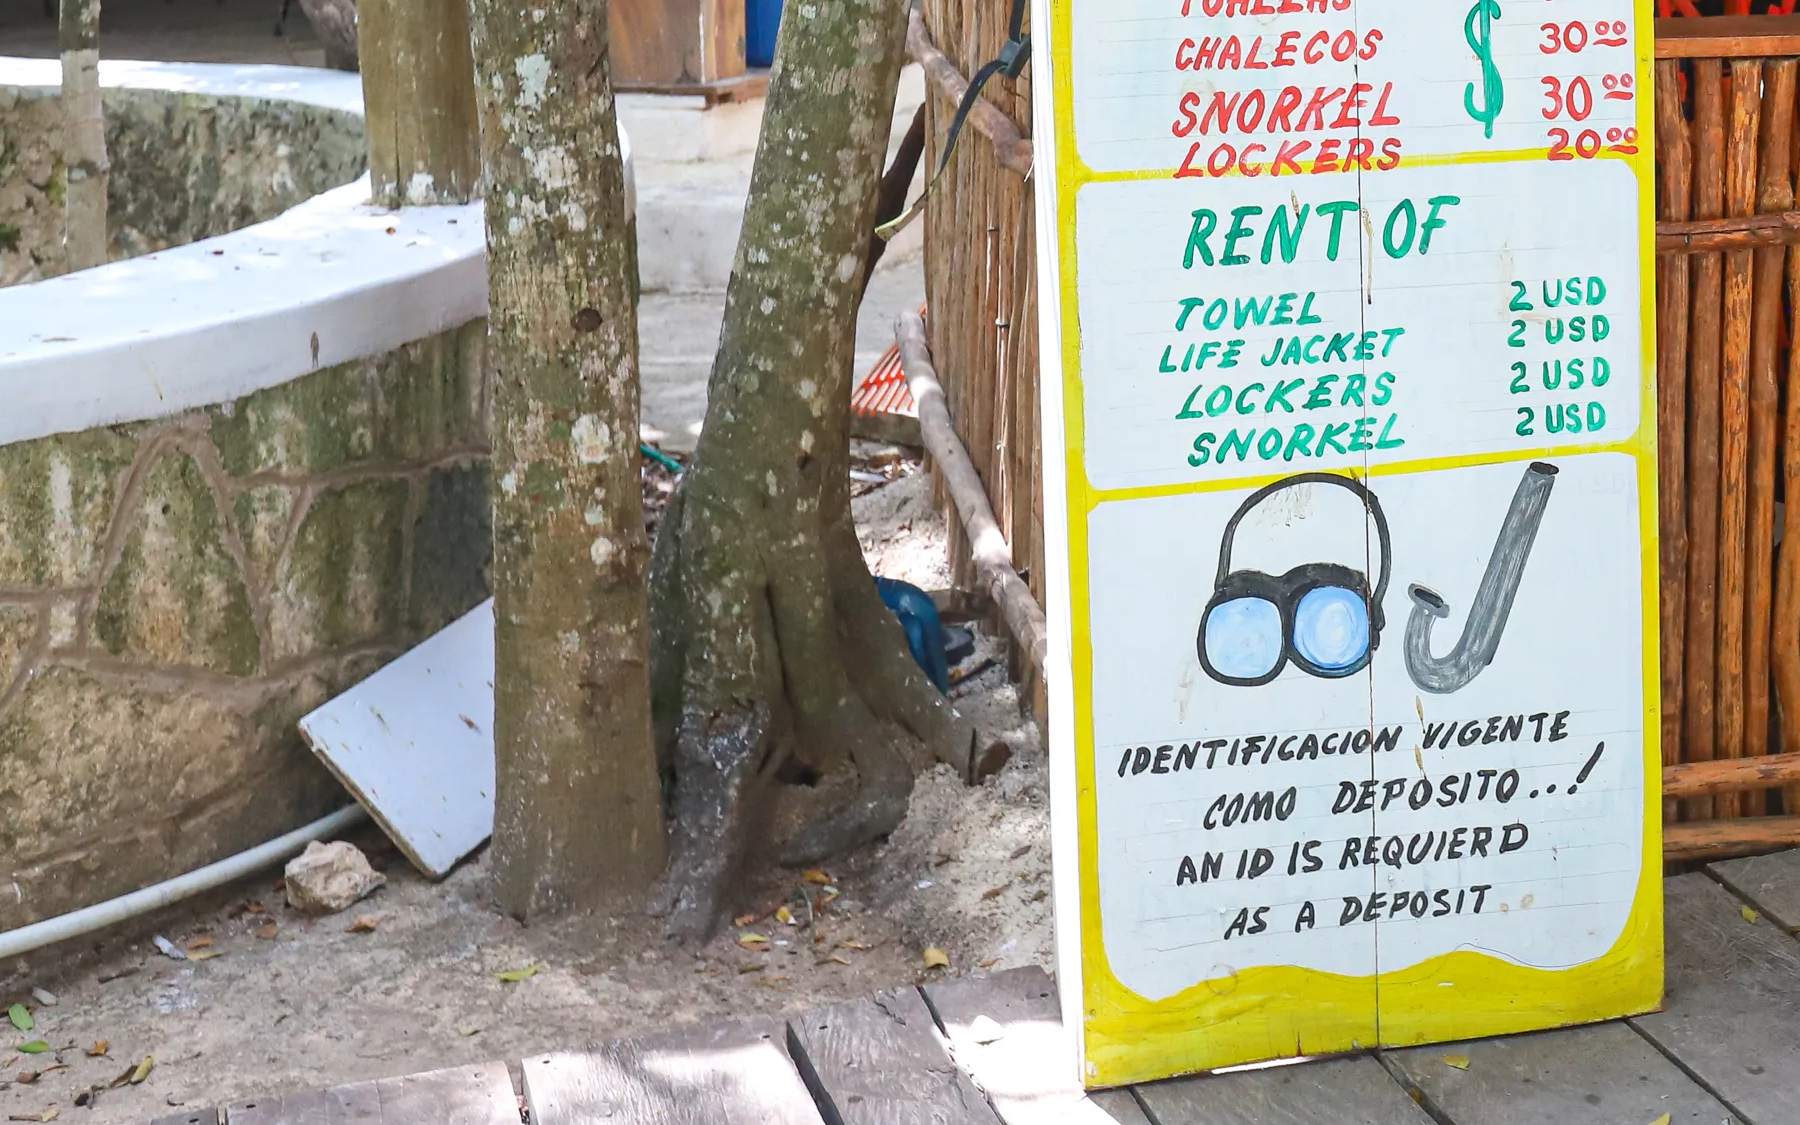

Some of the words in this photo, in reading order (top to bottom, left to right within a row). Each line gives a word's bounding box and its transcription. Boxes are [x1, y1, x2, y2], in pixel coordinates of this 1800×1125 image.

[1175, 28, 1384, 71] CHALECOS
[1172, 82, 1400, 138] SNORKEL
[1173, 138, 1402, 179] LOCKERS
[1182, 200, 1361, 270] RENT
[1382, 194, 1461, 260] OF
[1175, 291, 1322, 332] TOWEL
[1509, 280, 1535, 312] 2
[1543, 275, 1608, 308] USD
[1159, 338, 1246, 374] LIFE
[1260, 326, 1407, 368] JACKET
[1507, 319, 1528, 348] 2
[1545, 314, 1612, 346] USD
[1176, 372, 1396, 420] LOCKERS
[1509, 362, 1531, 394] 2
[1542, 356, 1612, 391] USD
[1188, 414, 1405, 467] SNORKEL
[1515, 406, 1536, 437] 2
[1545, 401, 1608, 435] USD
[1118, 725, 1403, 778] IDENTIFICACION
[1422, 710, 1571, 750] VIGENTE
[1203, 786, 1297, 830] COMO
[1176, 851, 1223, 887] AN
[1236, 848, 1274, 880] ID
[1287, 840, 1324, 876] IS
[1338, 822, 1529, 872] REQUIERD
[1223, 906, 1269, 940] AS
[1294, 900, 1315, 933] A
[1339, 884, 1492, 926] DEPOSIT
